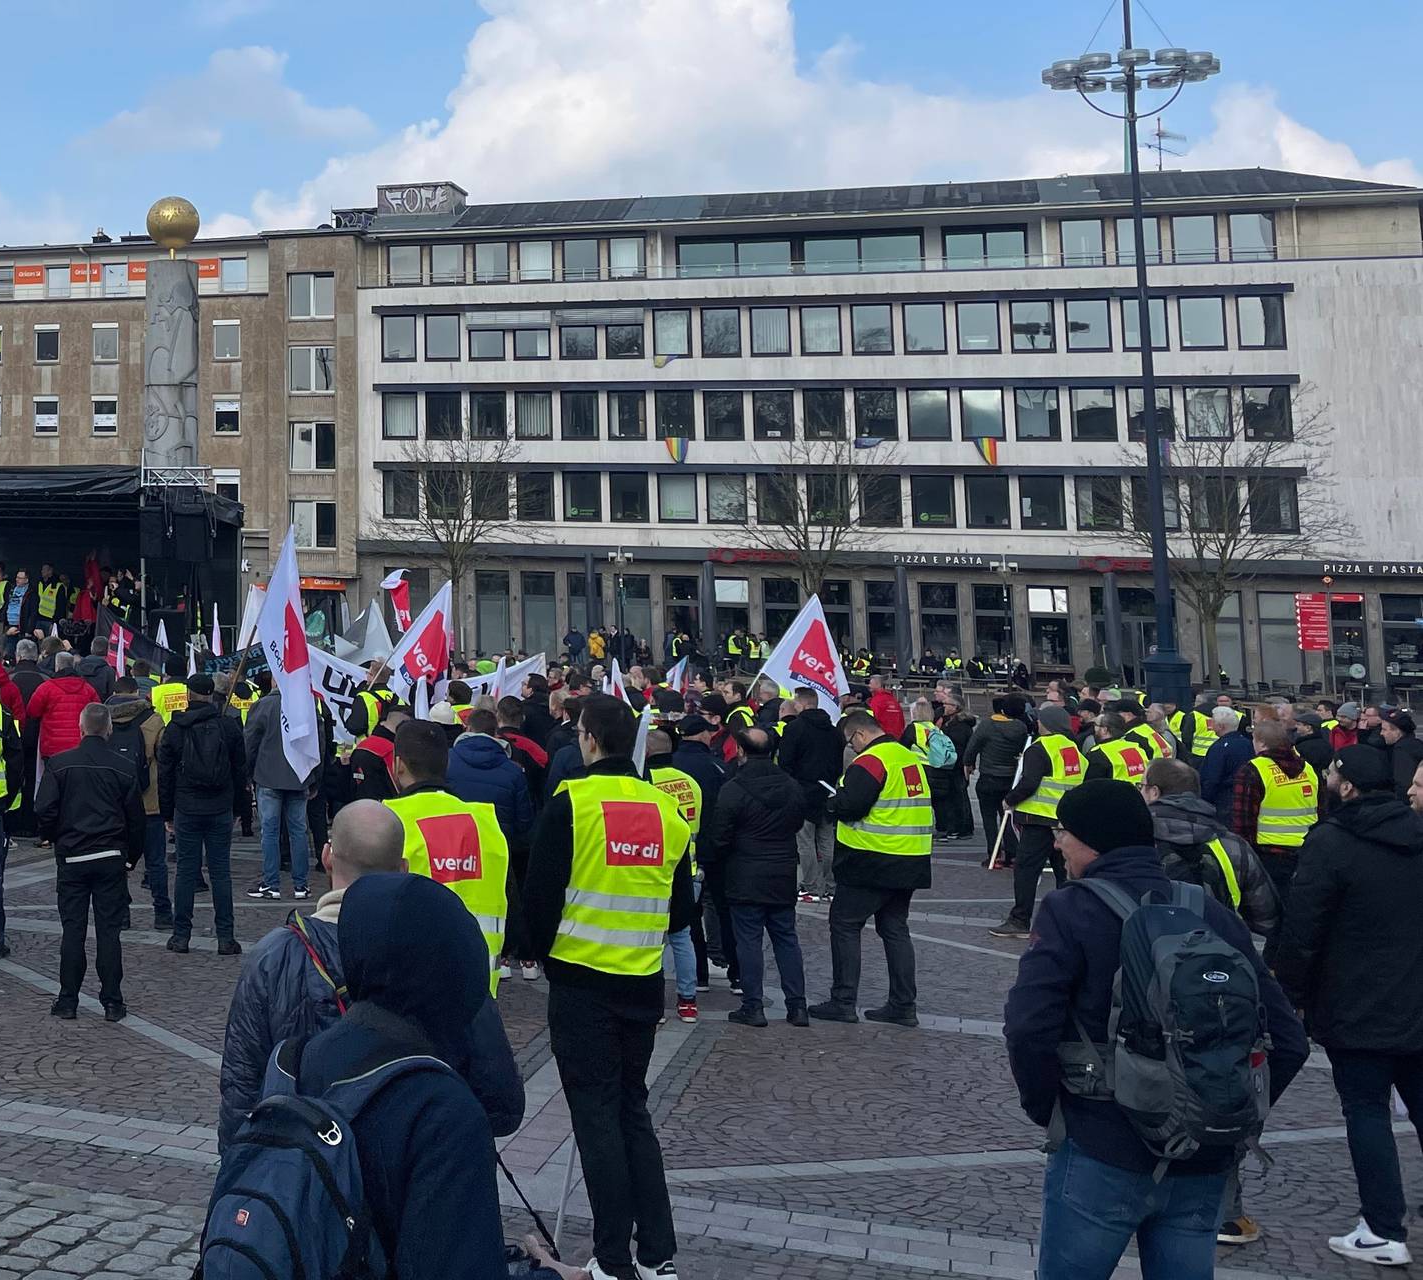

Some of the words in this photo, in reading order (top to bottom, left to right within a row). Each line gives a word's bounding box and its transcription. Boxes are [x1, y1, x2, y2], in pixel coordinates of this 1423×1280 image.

[893, 554, 927, 565] PIZZA
[933, 556, 939, 564] E
[945, 556, 983, 565] PASTA
[1323, 564, 1361, 574] PIZZA
[1368, 564, 1375, 574] E
[1382, 565, 1423, 575] PASTA
[797, 674, 836, 700] Dortmund
[609, 840, 659, 859] ver.di
